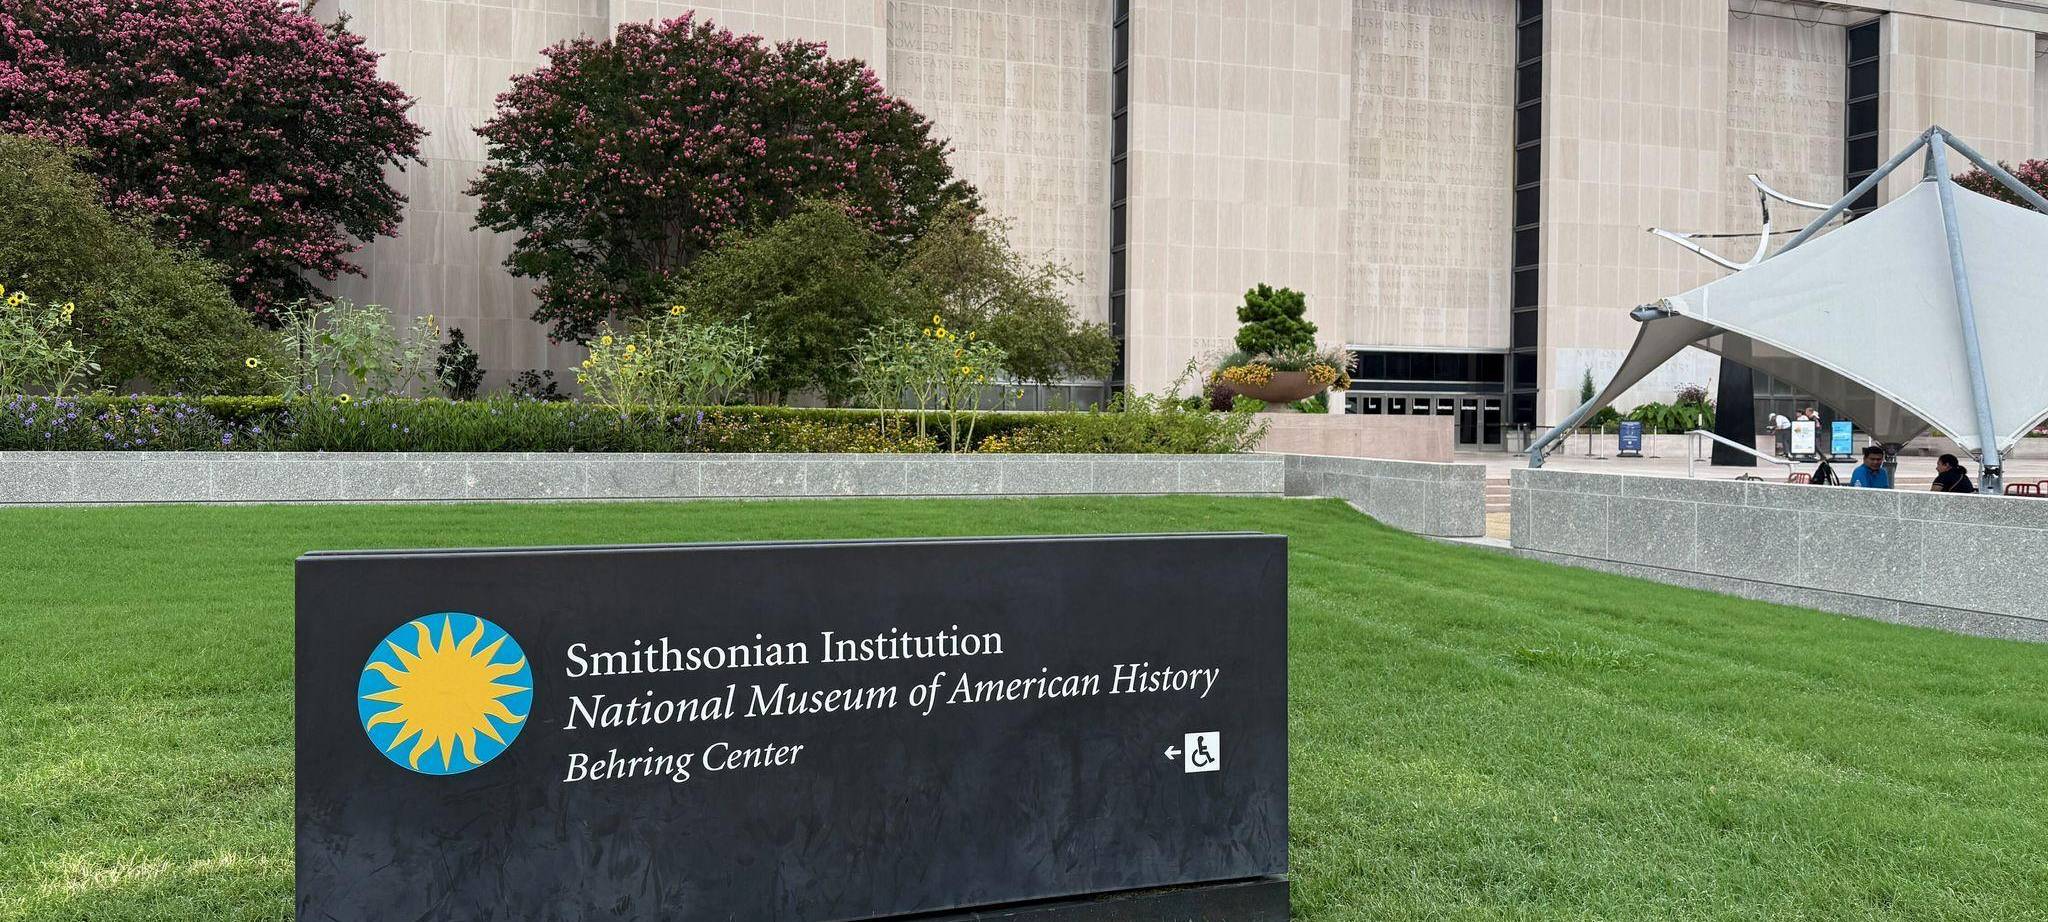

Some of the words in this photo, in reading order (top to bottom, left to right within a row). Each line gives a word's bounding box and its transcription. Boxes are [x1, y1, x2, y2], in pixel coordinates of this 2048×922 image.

[565, 631, 810, 678] Smithsonian
[820, 624, 1004, 663] Institution
[562, 683, 736, 731] National
[743, 684, 899, 718] Museum
[908, 671, 948, 717] of
[945, 666, 1101, 704] American
[1108, 661, 1220, 699] History
[562, 746, 695, 784] Behring
[702, 742, 805, 772] Center
